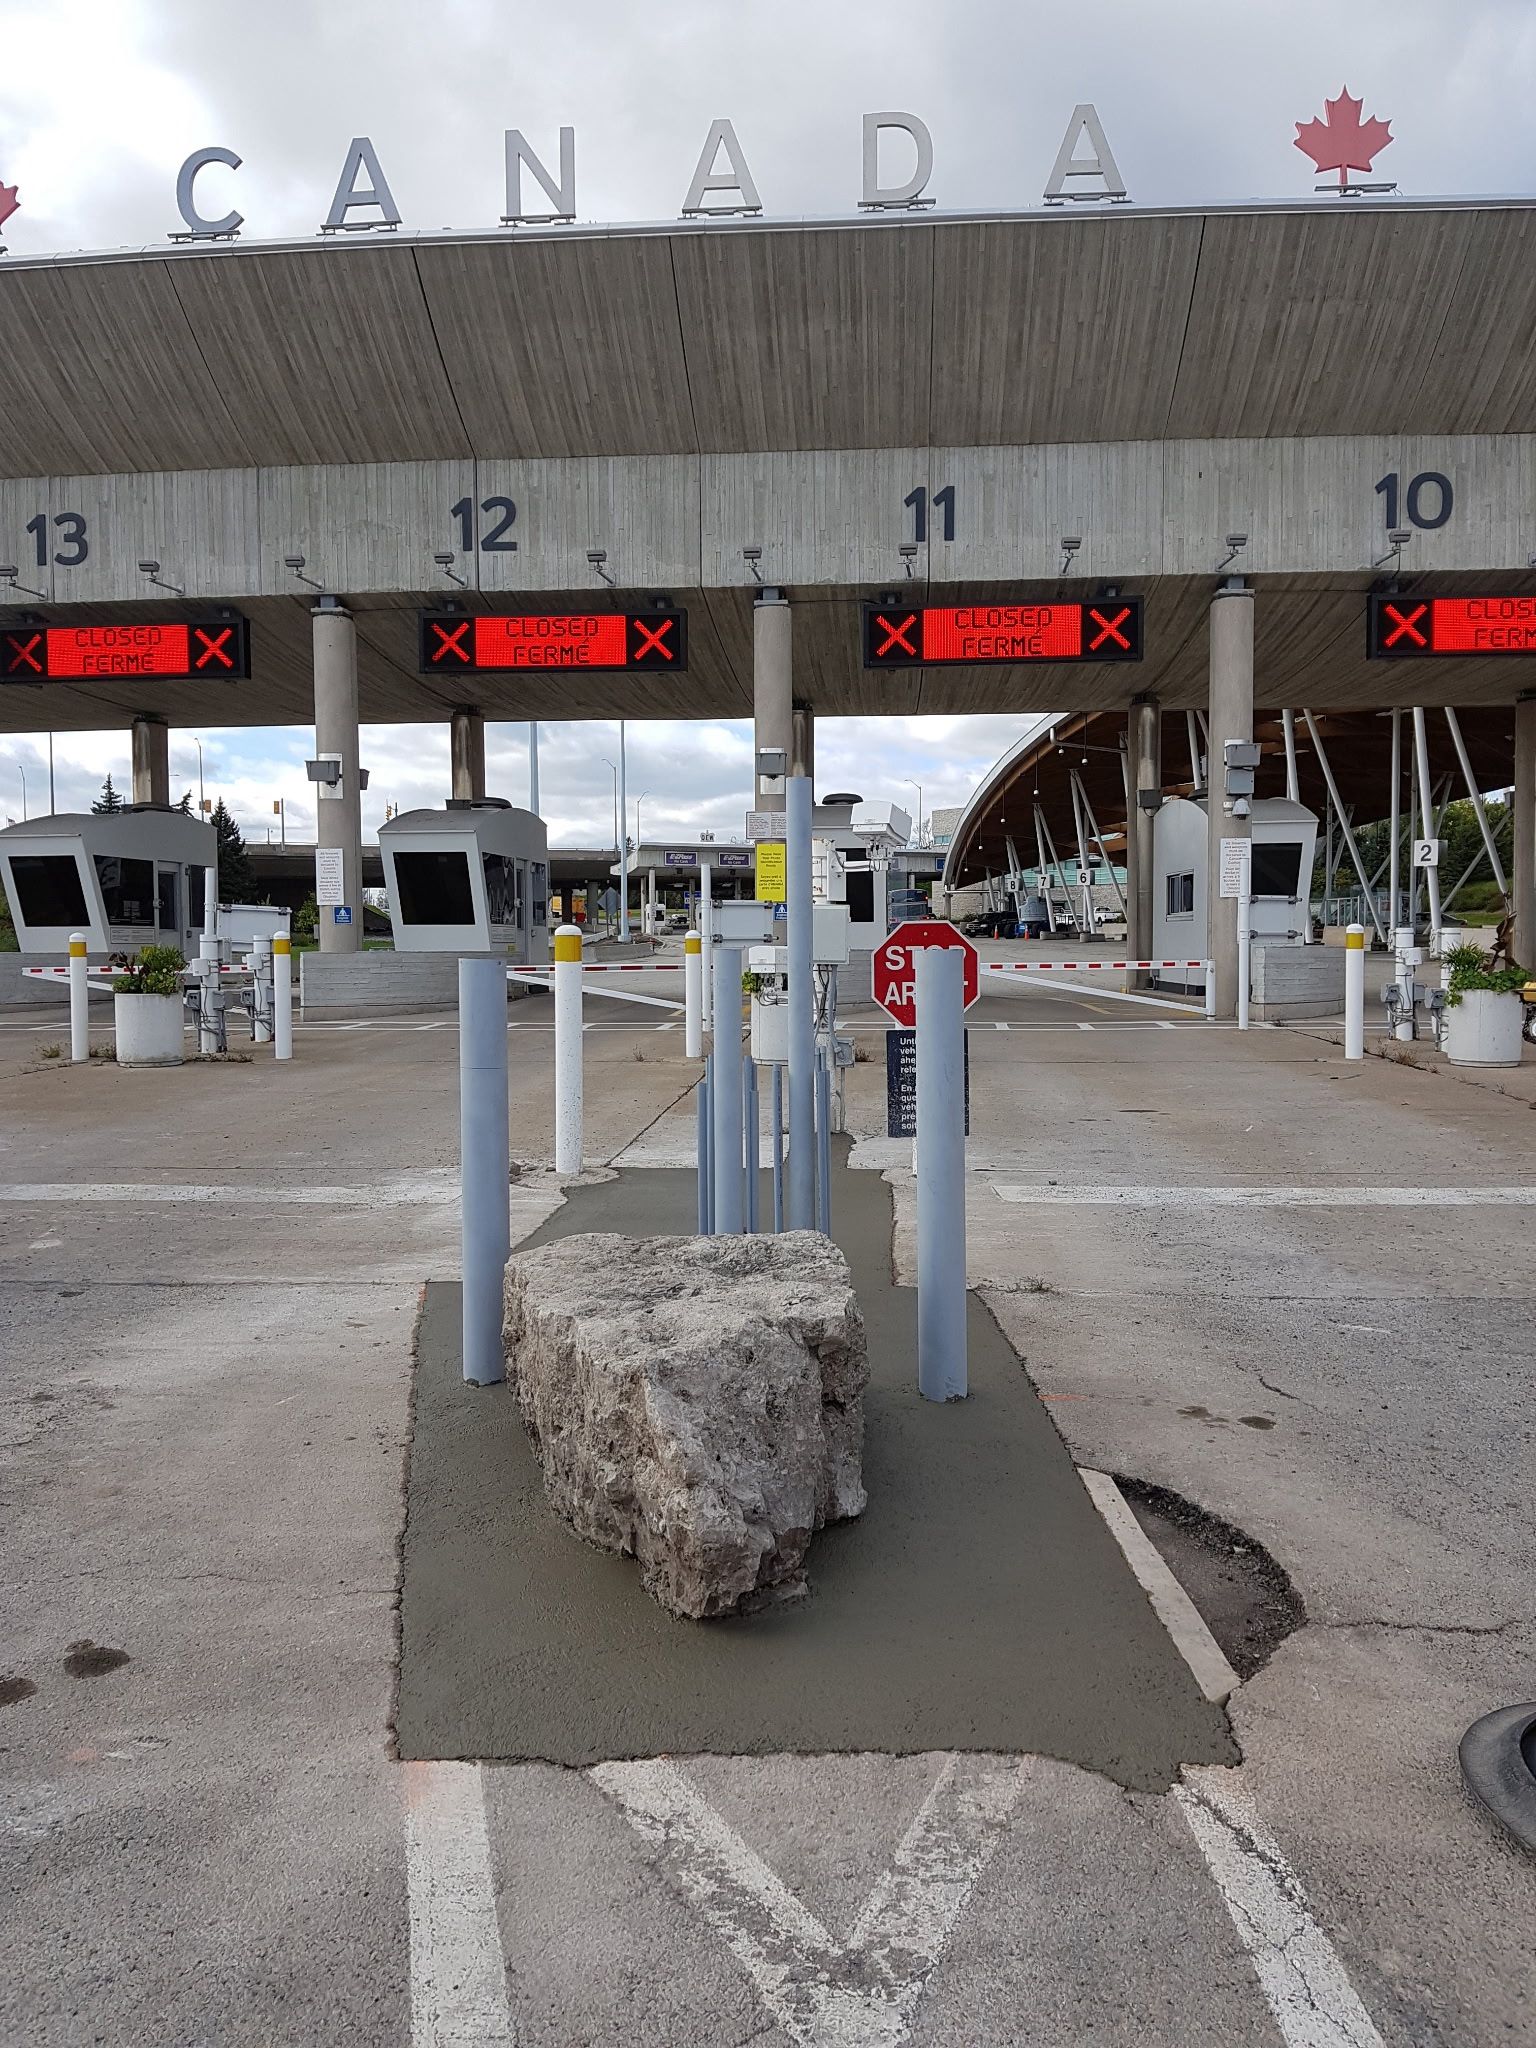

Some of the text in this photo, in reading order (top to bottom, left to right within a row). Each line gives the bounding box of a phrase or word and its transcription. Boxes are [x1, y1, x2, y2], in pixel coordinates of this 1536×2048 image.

[176, 103, 1127, 233] CANADA
[1374, 472, 1453, 530] 10
[450, 496, 518, 553] 12
[904, 486, 956, 542] 11
[25, 512, 88, 566] 13
[954, 608, 1053, 629] CLOSED
[1466, 599, 1536, 620] CLOS
[74, 626, 162, 648] CLOSED
[505, 618, 599, 638] CLOSED
[512, 638, 591, 665] FERMÉ
[961, 627, 1043, 657] FERMÉ
[82, 648, 155, 673] FERMÉ
[1420, 844, 1433, 862] 2
[1010, 880, 1016, 890] 8
[1041, 877, 1047, 887] 7
[1080, 873, 1087, 883] 6
